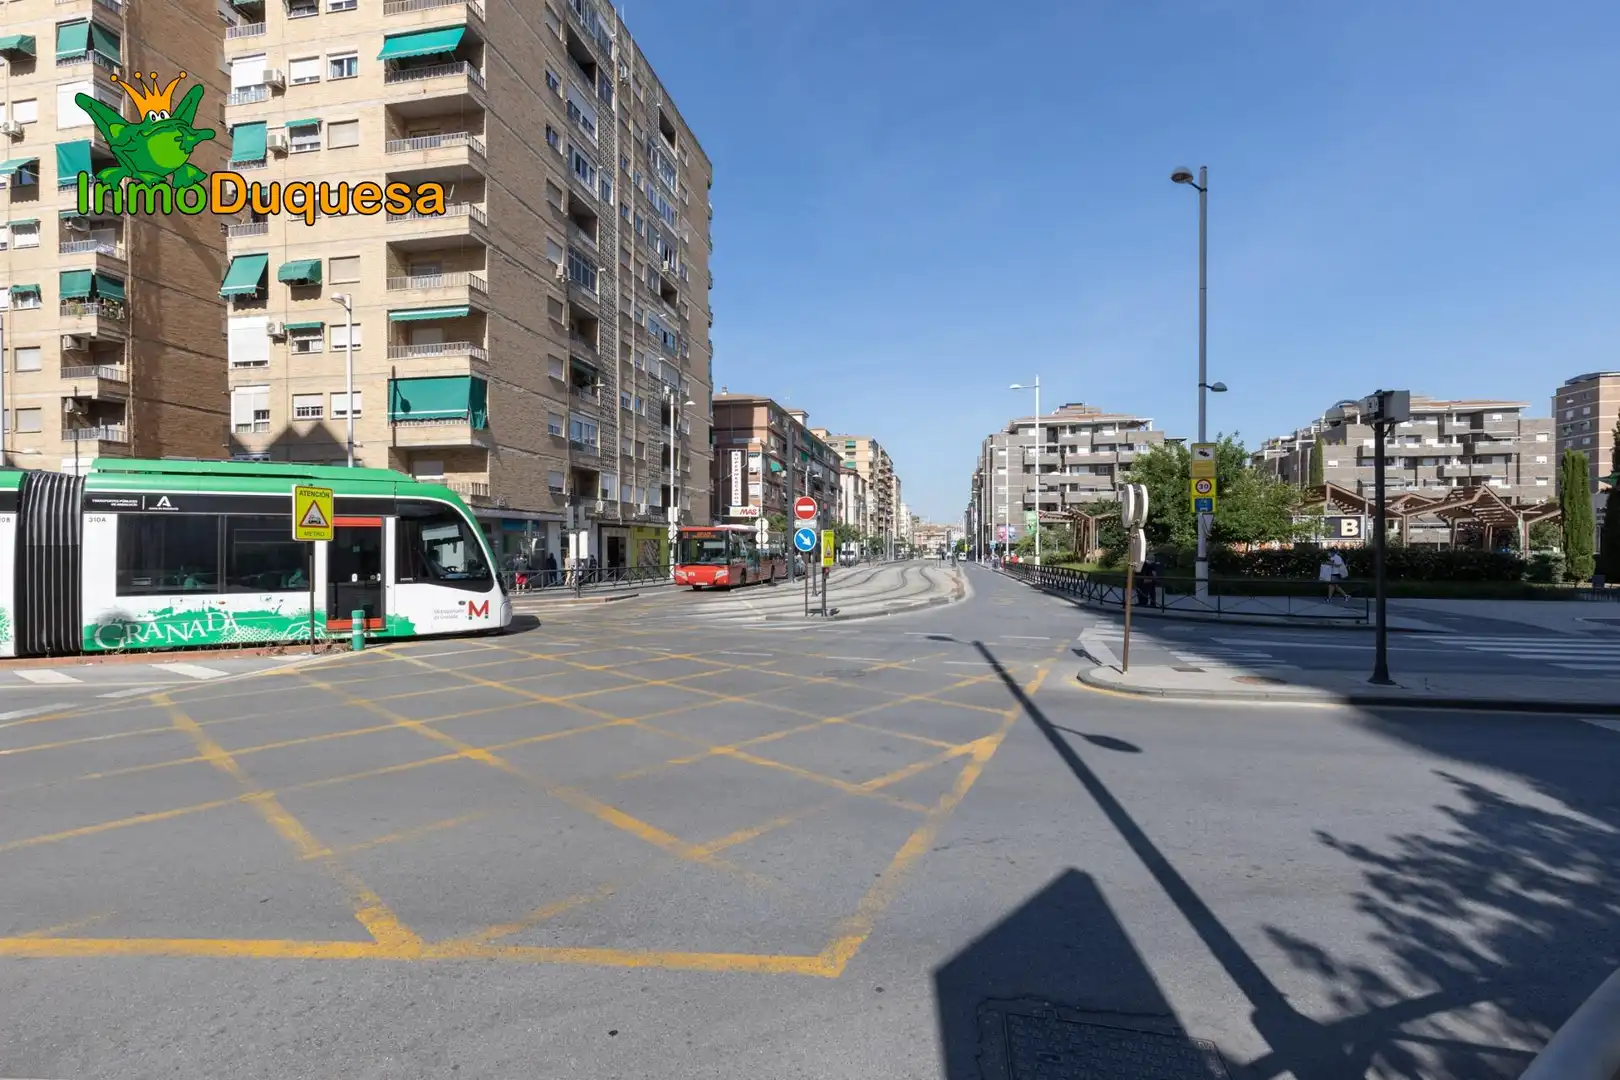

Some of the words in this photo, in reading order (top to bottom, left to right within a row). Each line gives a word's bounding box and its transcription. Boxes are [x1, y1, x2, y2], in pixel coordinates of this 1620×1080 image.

[298, 490, 330, 498] ATENCIÓN
[739, 508, 757, 516] MAS
[1340, 518, 1360, 537] B
[468, 599, 489, 620] M
[95, 611, 241, 650] GRANADA
